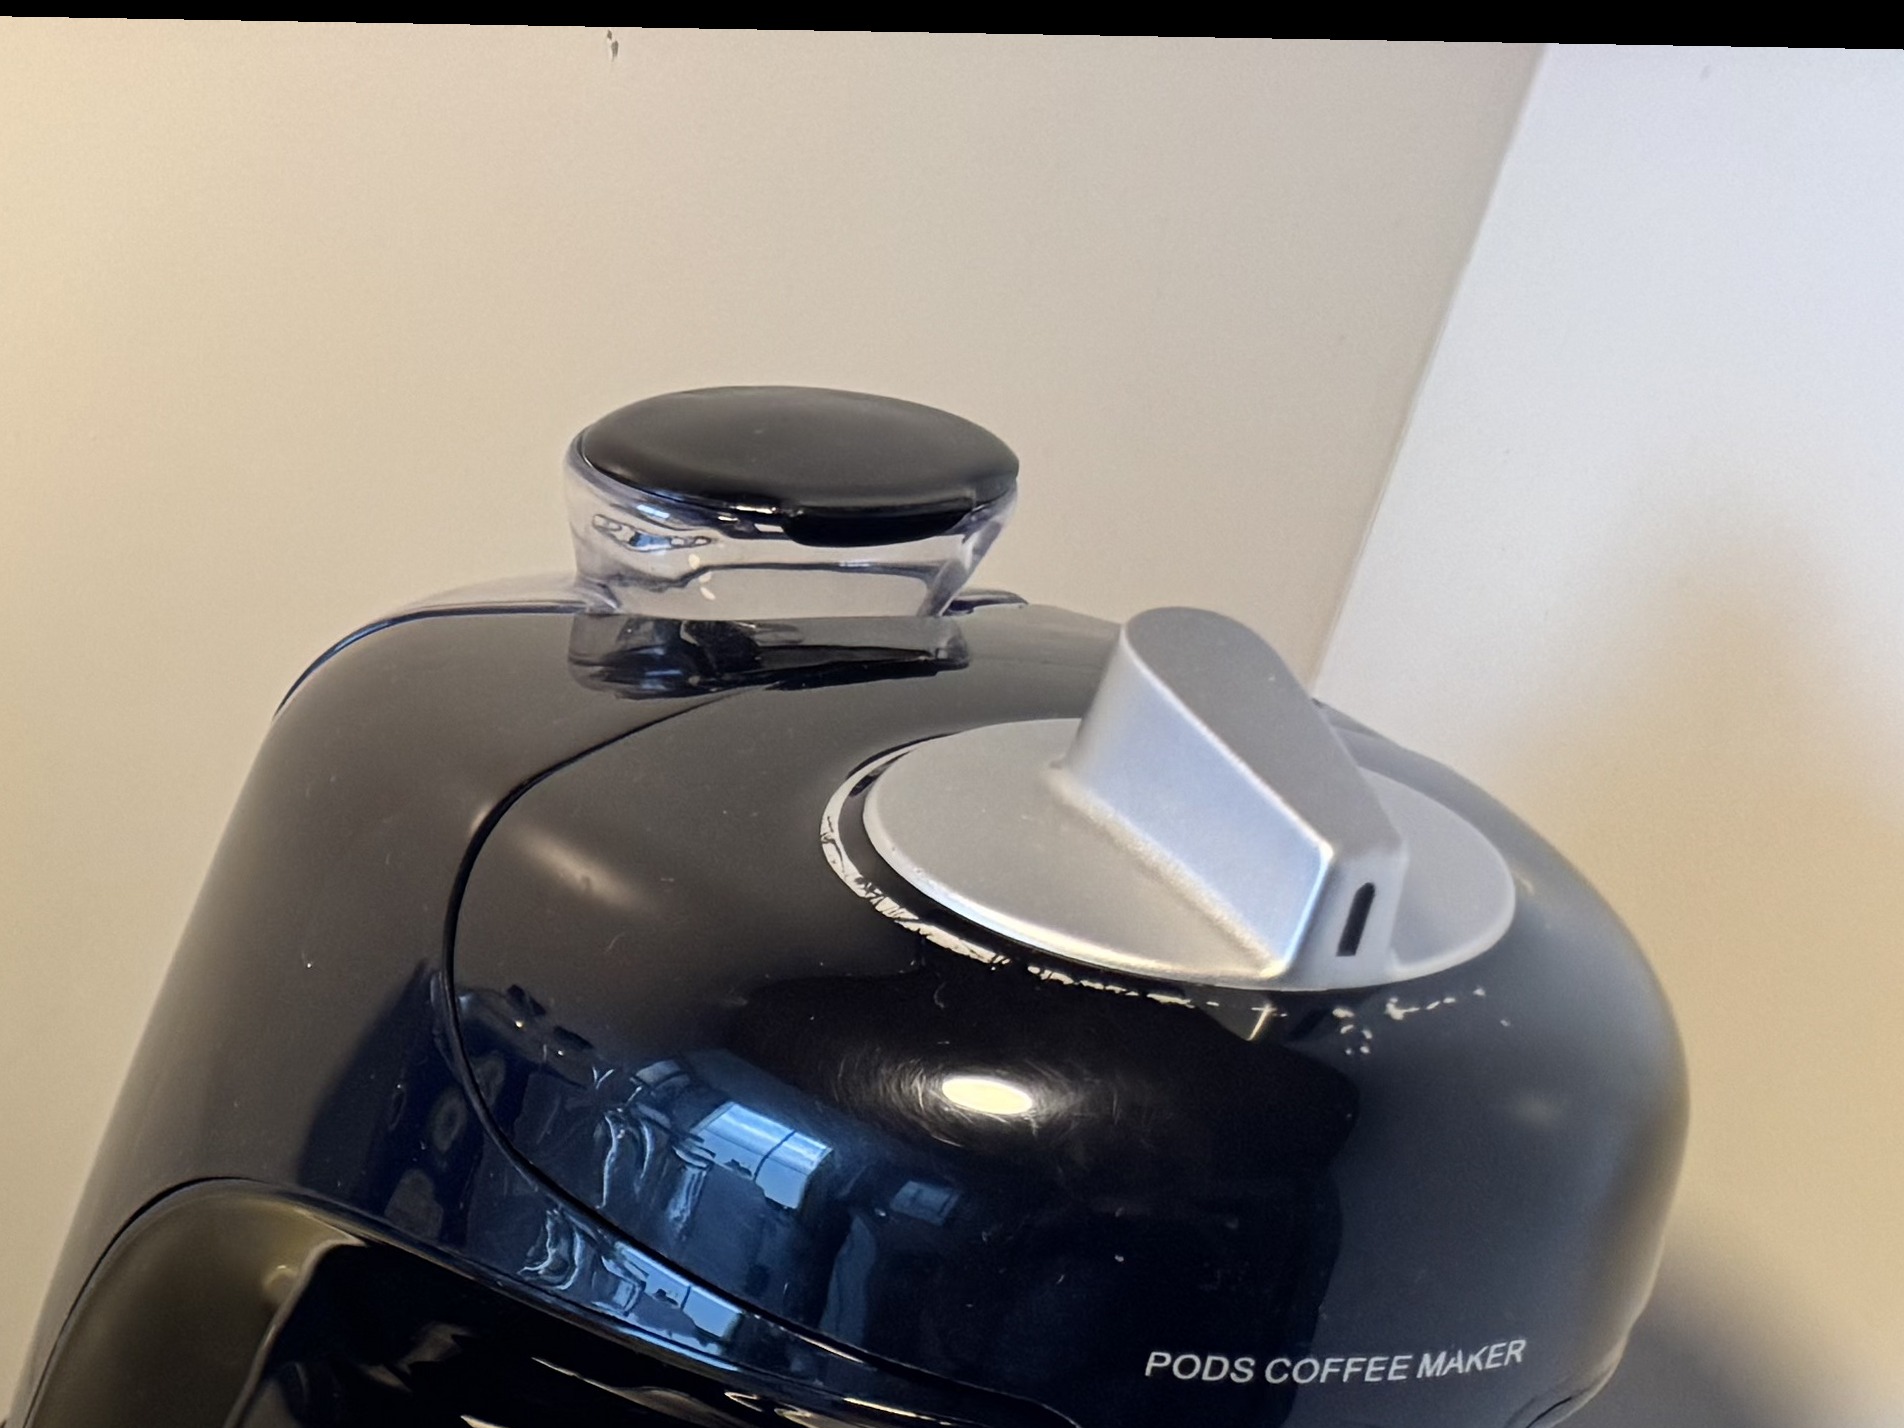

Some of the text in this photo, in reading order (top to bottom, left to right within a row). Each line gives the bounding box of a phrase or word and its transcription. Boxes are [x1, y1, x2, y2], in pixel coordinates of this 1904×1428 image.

[1144, 1339, 1527, 1385] PODS COFFEE MAKER
